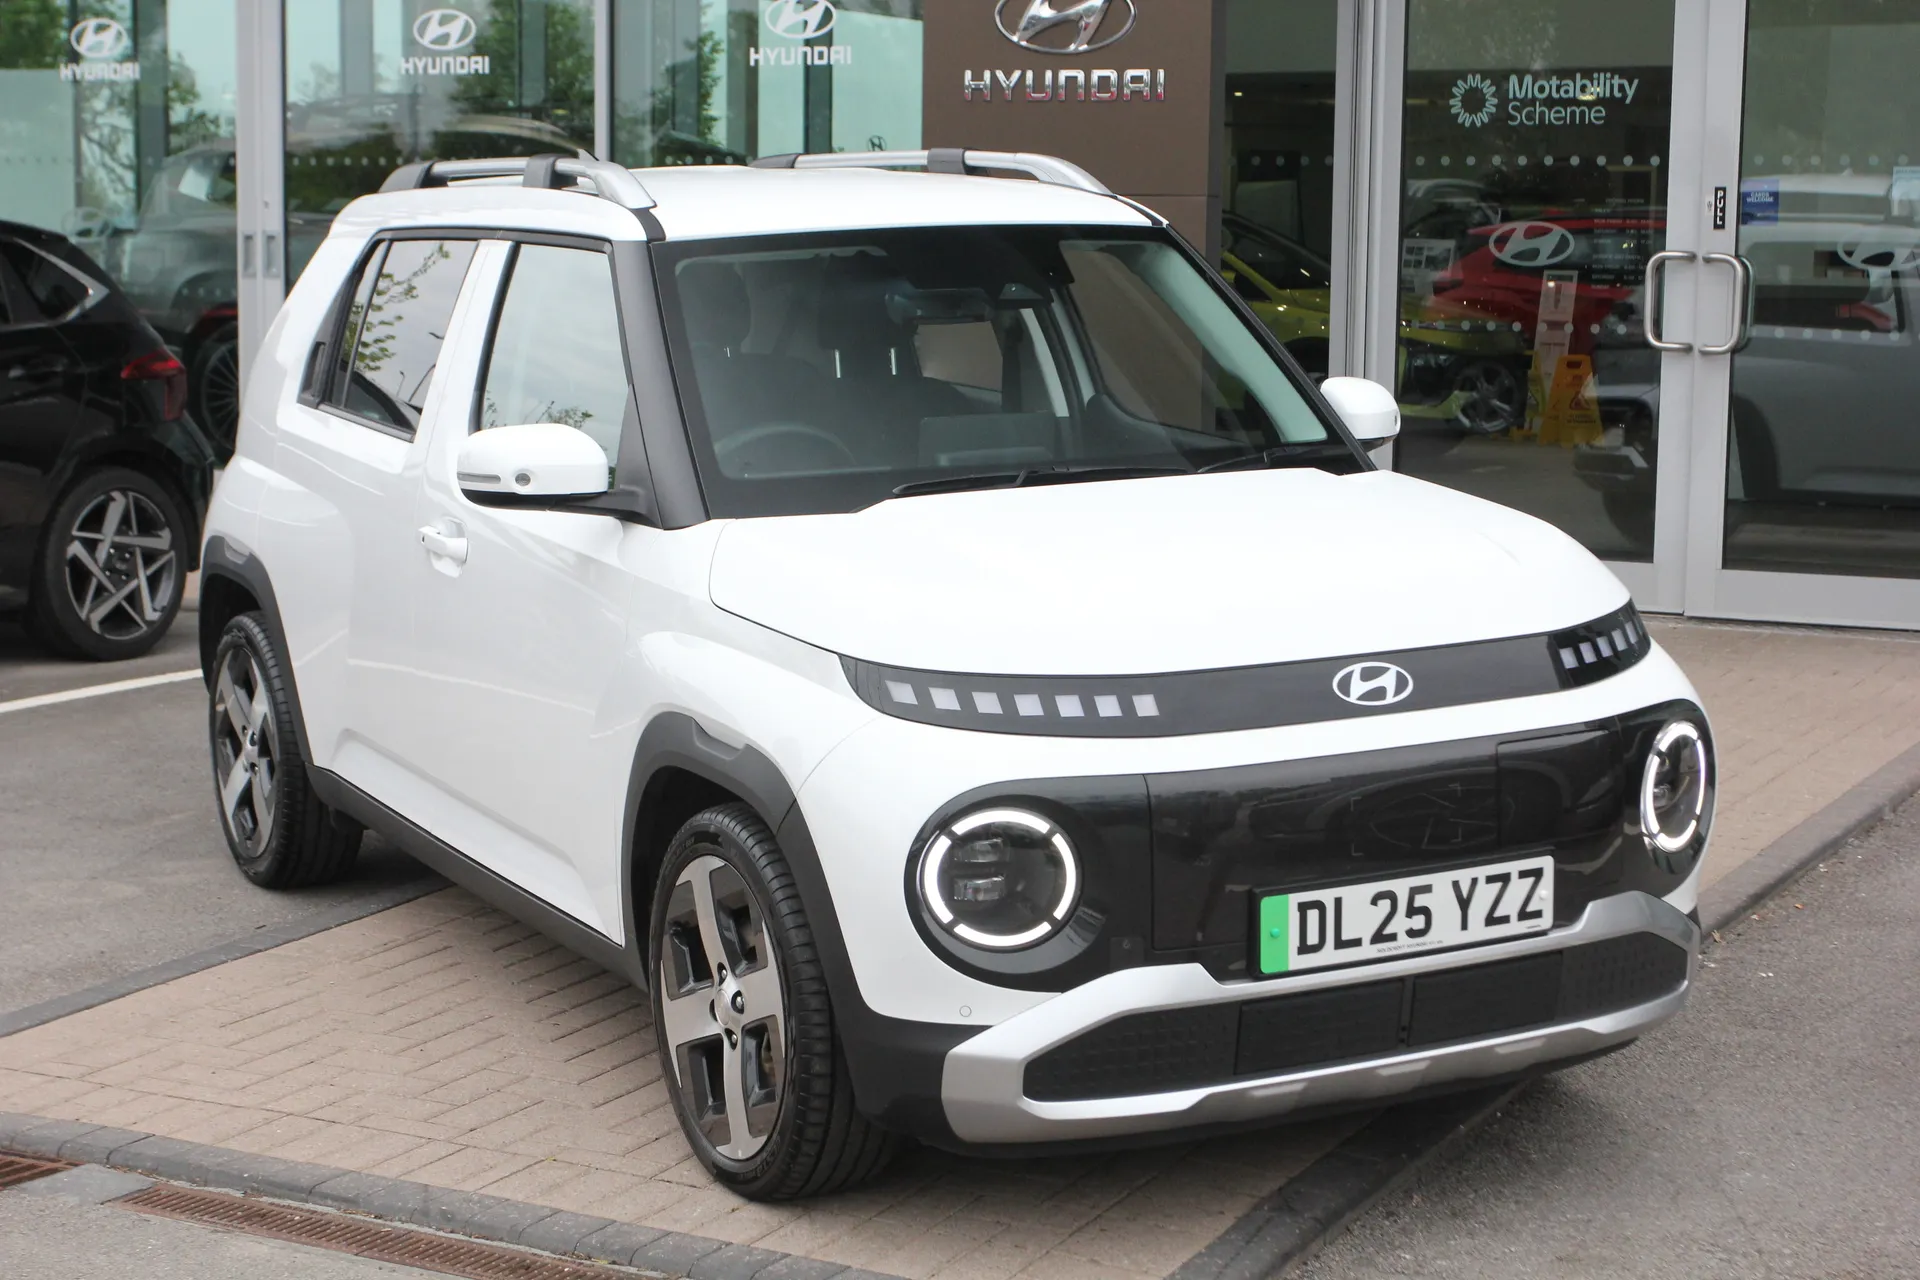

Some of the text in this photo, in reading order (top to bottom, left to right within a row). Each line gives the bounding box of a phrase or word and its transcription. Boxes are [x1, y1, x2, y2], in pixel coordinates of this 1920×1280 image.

[401, 55, 490, 75] HYUNDAI
[749, 45, 852, 66] HYUNDAI
[60, 62, 140, 81] HYUNDAI
[964, 68, 1165, 101] HYUNDAI
[1508, 72, 1639, 104] Motability
[1508, 101, 1606, 125] Scheme
[1716, 190, 1724, 225] PULL
[1297, 867, 1545, 956] DL25 YZZ
